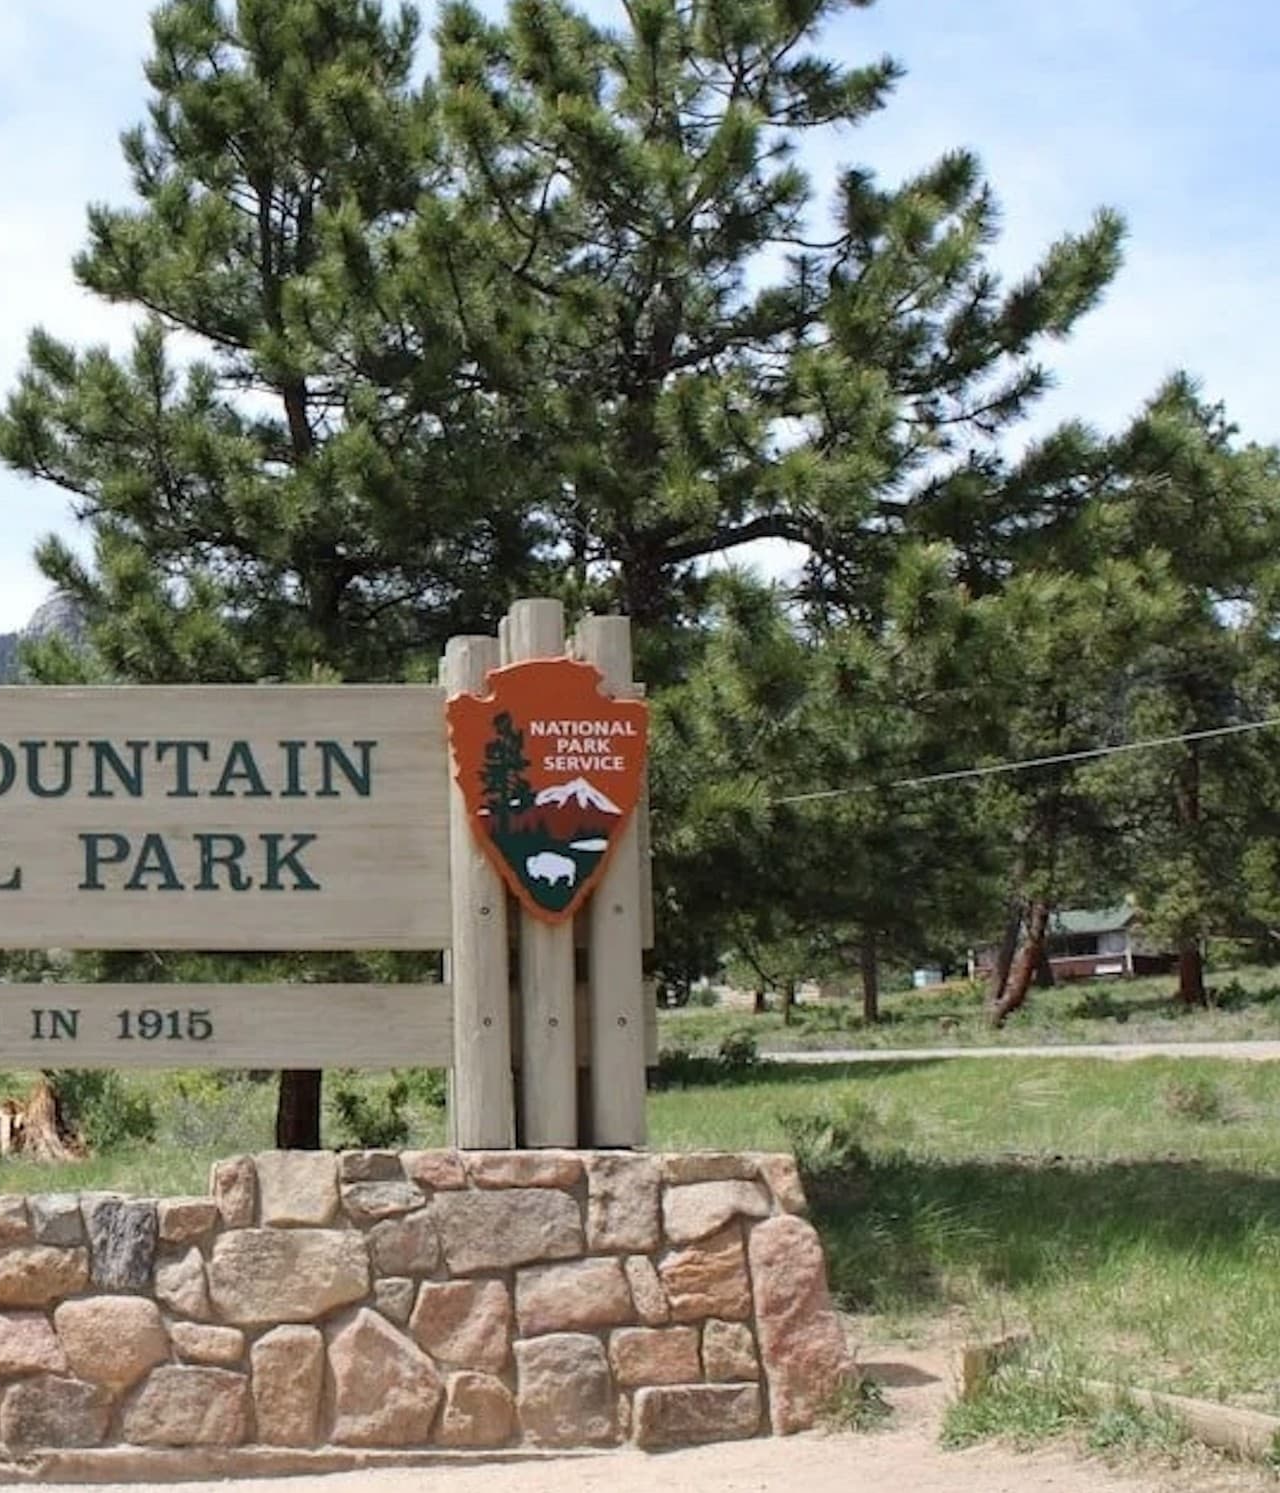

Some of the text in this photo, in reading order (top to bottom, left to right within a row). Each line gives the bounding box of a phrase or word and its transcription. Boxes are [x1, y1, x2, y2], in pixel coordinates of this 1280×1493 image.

[530, 720, 637, 736] NATIONAL
[557, 738, 610, 753] PARK
[543, 756, 625, 770] SERVICE
[78, 833, 321, 891] PARK
[32, 1010, 80, 1039] IN
[117, 1010, 213, 1041] 1915
